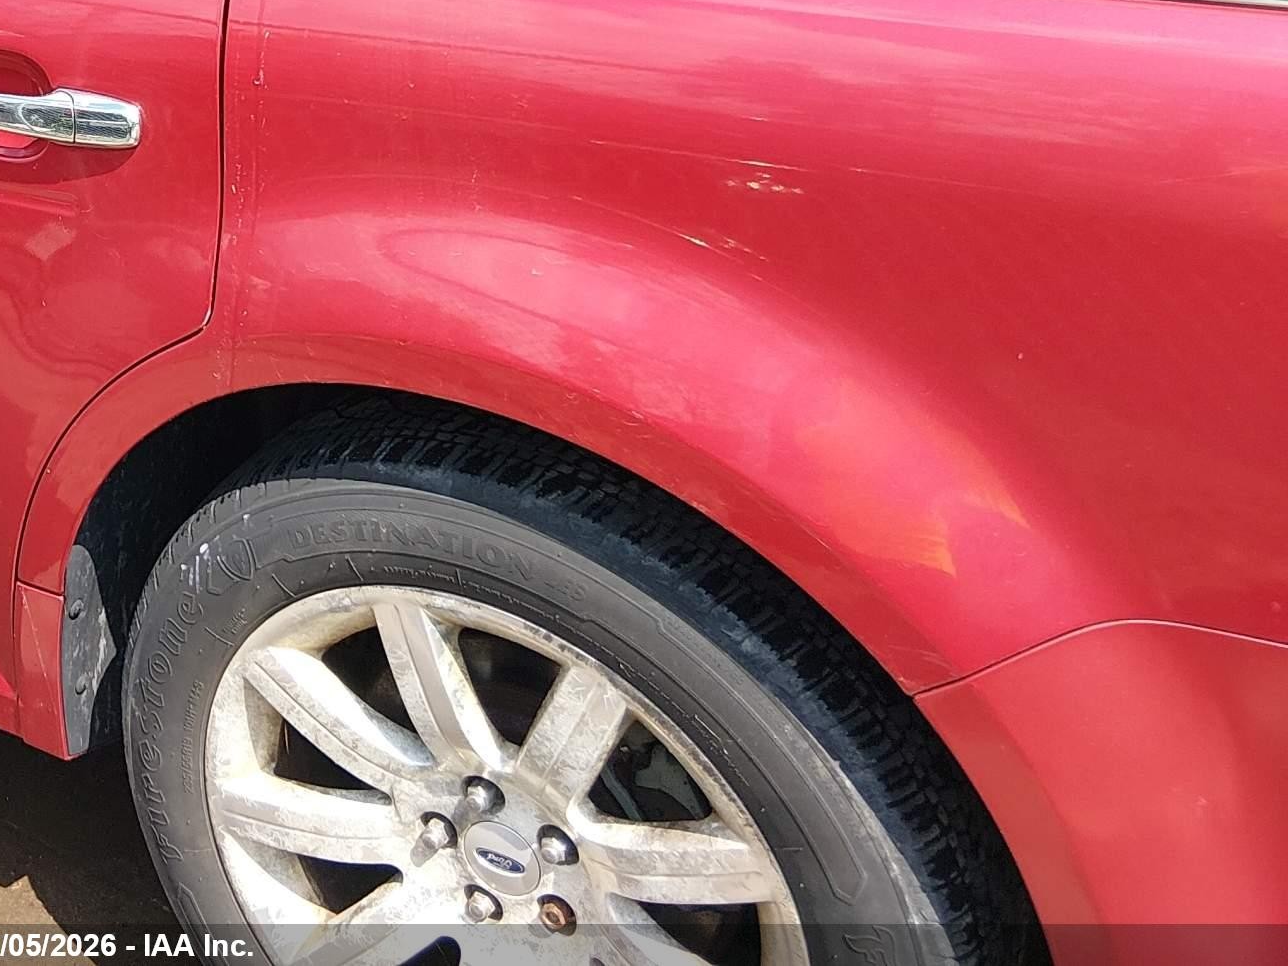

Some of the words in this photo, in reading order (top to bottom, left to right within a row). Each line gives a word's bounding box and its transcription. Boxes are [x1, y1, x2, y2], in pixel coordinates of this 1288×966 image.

[289, 519, 533, 581] DESTINATION
[134, 591, 203, 864] Firestone
[487, 852, 513, 870] Ford
